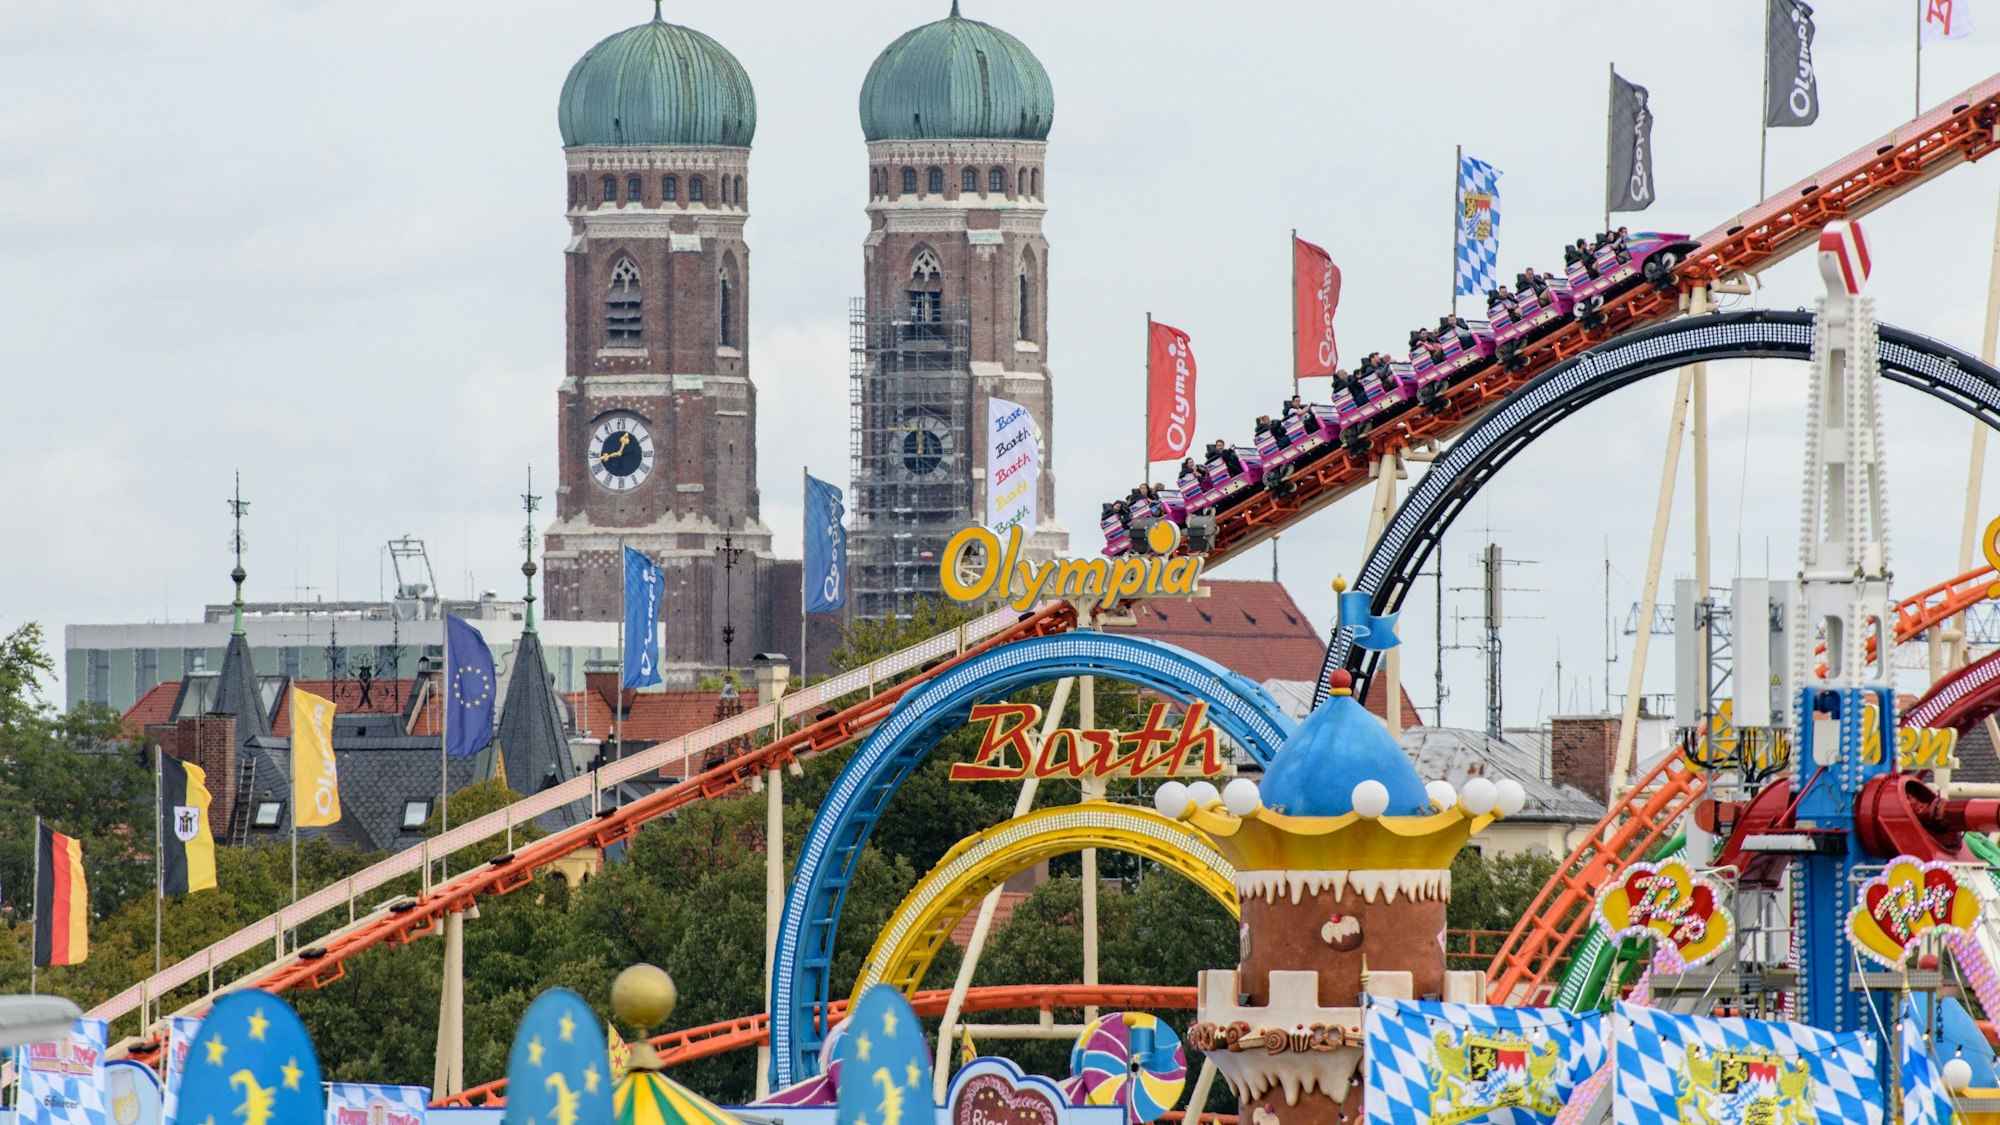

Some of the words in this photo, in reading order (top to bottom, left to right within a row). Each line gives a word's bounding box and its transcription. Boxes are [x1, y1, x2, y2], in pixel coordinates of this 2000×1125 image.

[995, 407, 1029, 432] Barth
[1167, 335, 1189, 451] Olympia
[995, 427, 1031, 459] Barth
[995, 452, 1031, 486] Barth
[994, 505, 1030, 534] Barth
[940, 519, 1202, 612] Olympia
[641, 565, 656, 676] Ompia
[949, 702, 1224, 781] Barth
